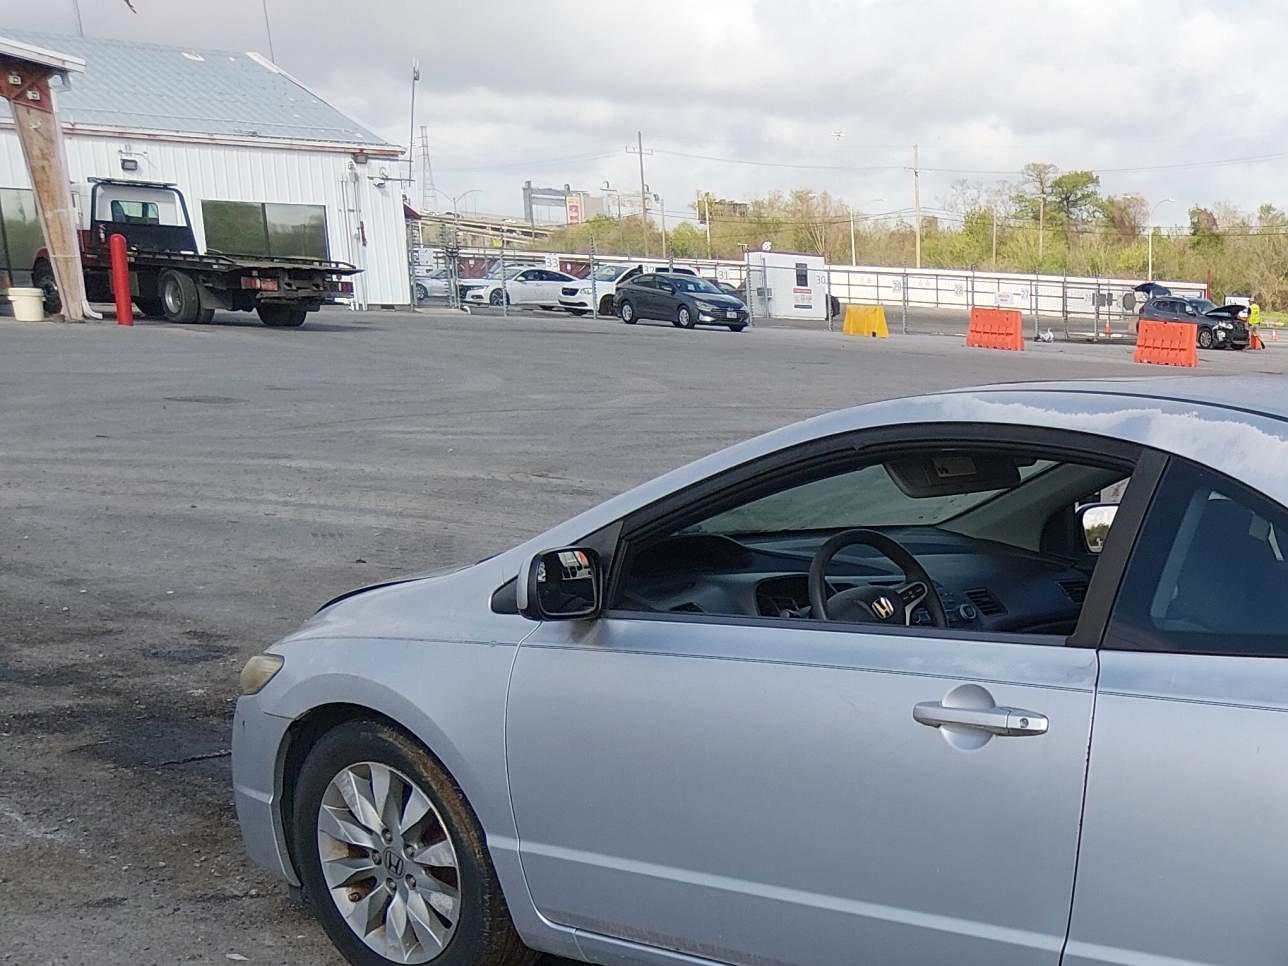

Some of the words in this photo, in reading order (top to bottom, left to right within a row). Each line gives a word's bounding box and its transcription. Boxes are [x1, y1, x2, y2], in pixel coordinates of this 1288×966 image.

[546, 257, 559, 268] 33
[718, 270, 729, 281] 31
[816, 275, 826, 285] 30
